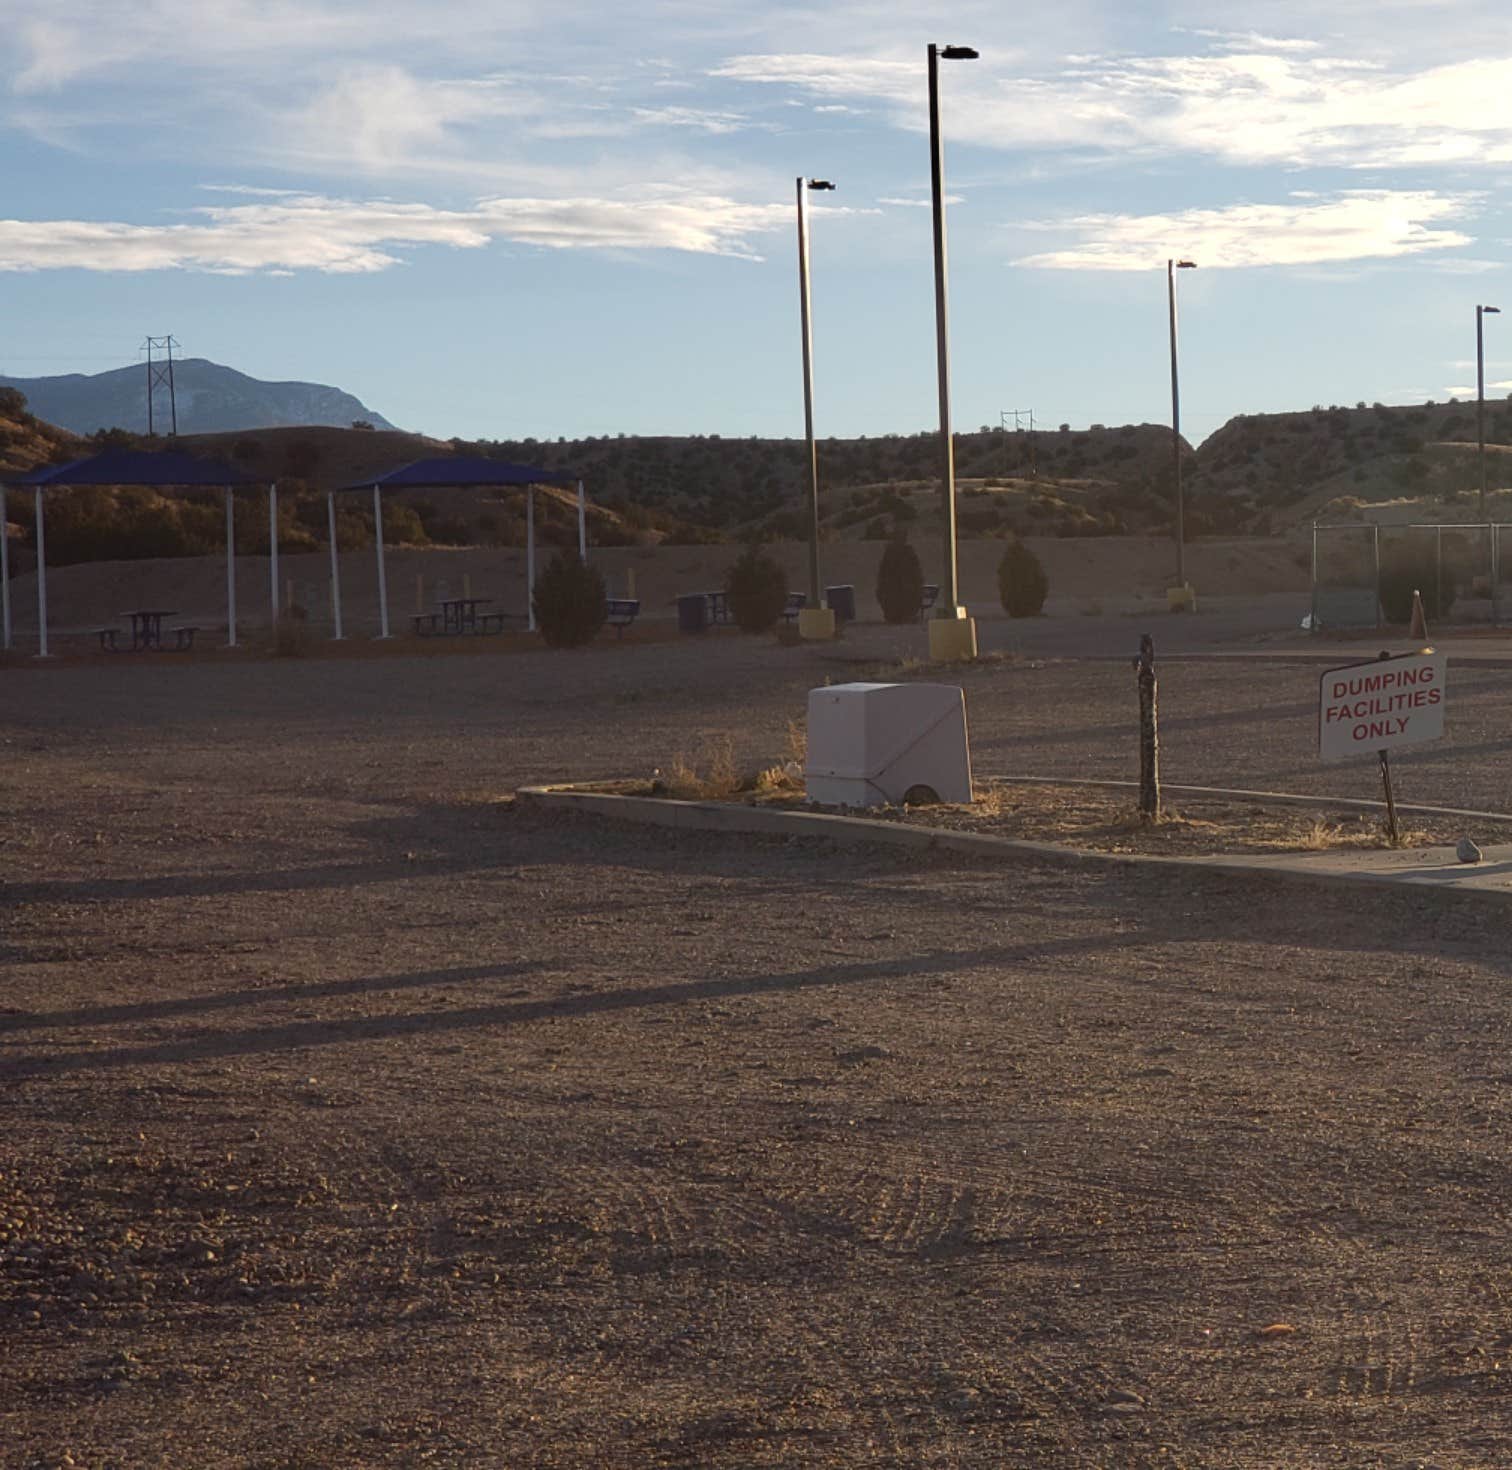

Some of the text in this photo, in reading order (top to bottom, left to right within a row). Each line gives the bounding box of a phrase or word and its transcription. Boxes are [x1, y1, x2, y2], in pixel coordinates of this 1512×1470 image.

[1333, 667, 1434, 698] DUMPING
[1326, 688, 1441, 723] FACILITIES
[1353, 717, 1410, 740] ONLY
